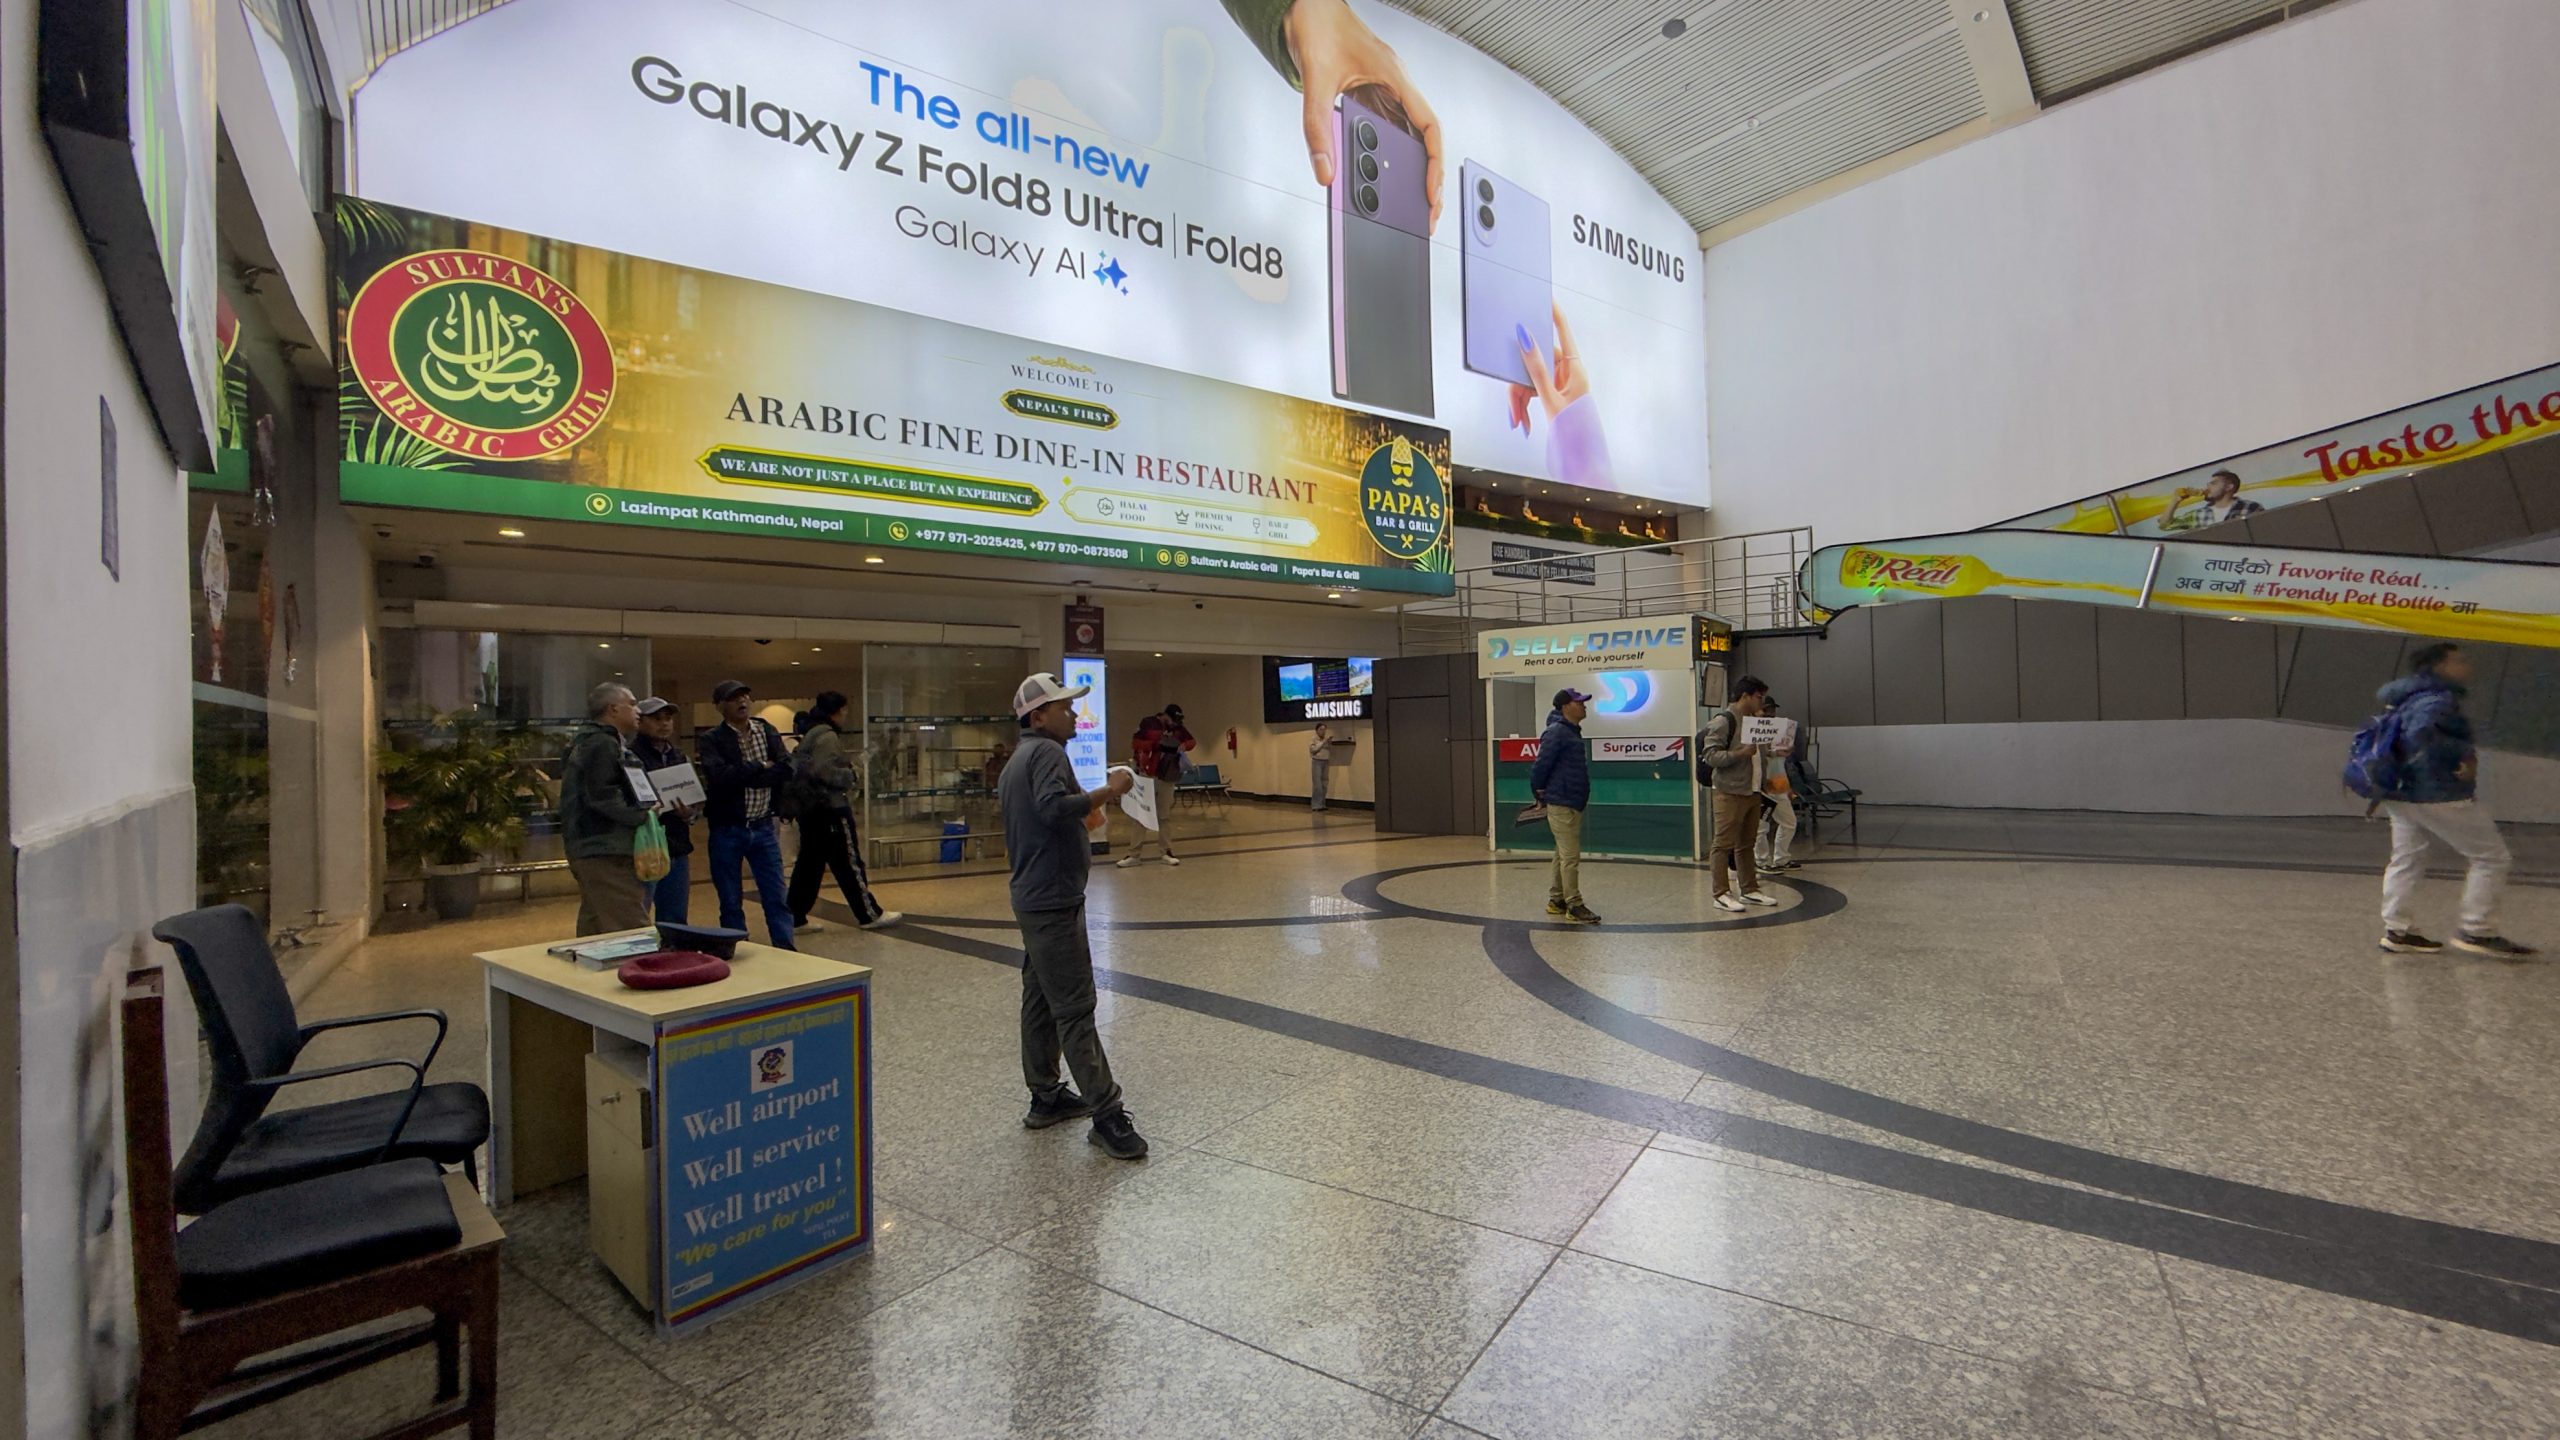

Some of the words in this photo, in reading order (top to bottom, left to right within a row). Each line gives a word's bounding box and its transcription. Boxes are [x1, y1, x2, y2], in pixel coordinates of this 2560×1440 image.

[859, 61, 961, 131] The
[976, 107, 1150, 190] all-new
[631, 56, 864, 172] Galaxy
[875, 131, 904, 177] Z
[918, 145, 1052, 218] Fold8
[1063, 188, 1164, 249] Ultra
[1186, 223, 1285, 280] Fold8
[894, 205, 1045, 279] Galaxy
[1056, 252, 1087, 282] AI
[1573, 213, 1685, 283] SAMSUNG
[405, 255, 575, 316] SULTAN'S
[1011, 364, 1092, 392] WELCOME
[1095, 381, 1114, 395] TO
[370, 379, 505, 457] ARABIC
[538, 388, 609, 450] GRILL
[1016, 396, 1070, 418] NEPAL'S
[1073, 407, 1111, 425] FIRST
[725, 391, 887, 442] ARABIC
[899, 418, 984, 458] FINE
[995, 432, 1126, 478] DINE-IN
[1135, 453, 1318, 504] RESTAURANT
[2303, 423, 2458, 482] Taste
[2469, 392, 2560, 440] the
[720, 457, 746, 472] WE
[747, 462, 778, 475] ARE
[782, 465, 813, 478] NOT
[815, 469, 849, 483] JUST
[850, 473, 861, 485] A
[863, 474, 907, 490] PLACE
[910, 480, 936, 493] BUT
[937, 484, 955, 497] AN
[958, 486, 1033, 506] EXPERIENCE
[620, 500, 699, 521] Lazimpat
[702, 508, 798, 530] Kathmandu,
[801, 516, 844, 533] Nepal
[1120, 500, 1148, 512] HALAL
[1120, 513, 1146, 523] FOOD
[1195, 511, 1233, 523] PREMIUM
[1195, 522, 1224, 533] DINING
[1375, 516, 1396, 529] BAR
[1398, 519, 1405, 530] &
[1408, 520, 1436, 534] GRILL
[915, 530, 946, 543] +977
[948, 532, 1027, 551] 971-2025425,
[1029, 541, 1056, 553] +977
[1058, 542, 1129, 560] 970-0873508
[1191, 555, 1228, 569] Sultan's
[1230, 559, 1259, 571] Arabic
[1260, 562, 1278, 574] Grill
[1292, 565, 1320, 579] Papa's
[1321, 568, 1335, 579] Bar
[1336, 570, 1343, 579] &
[1344, 571, 1360, 580] Grill
[2278, 561, 2365, 583] Favorite
[2175, 576, 2203, 592] अब
[2253, 582, 2338, 606] #Trendy
[2344, 588, 2376, 606] Pet
[2381, 592, 2446, 613] Bottle
[1524, 658, 1546, 667] Rent
[1556, 656, 1574, 665] car,
[1577, 654, 1601, 664] Drive
[1603, 651, 1645, 663] yourself
[1304, 700, 1362, 719] SAMSUNG
[1072, 733, 1104, 743] ELCOME
[1750, 727, 1779, 735] FRANK
[1074, 756, 1100, 767] NEPAL
[1081, 743, 1093, 754] TO
[1603, 742, 1656, 753] Surprice
[682, 1100, 744, 1142] Well
[752, 1077, 840, 1123] airport
[683, 1147, 744, 1190] Well
[752, 1124, 841, 1169] service
[683, 1193, 744, 1237] Well
[753, 1163, 826, 1214] travel
[722, 1223, 766, 1250] care
[771, 1209, 799, 1231] for
